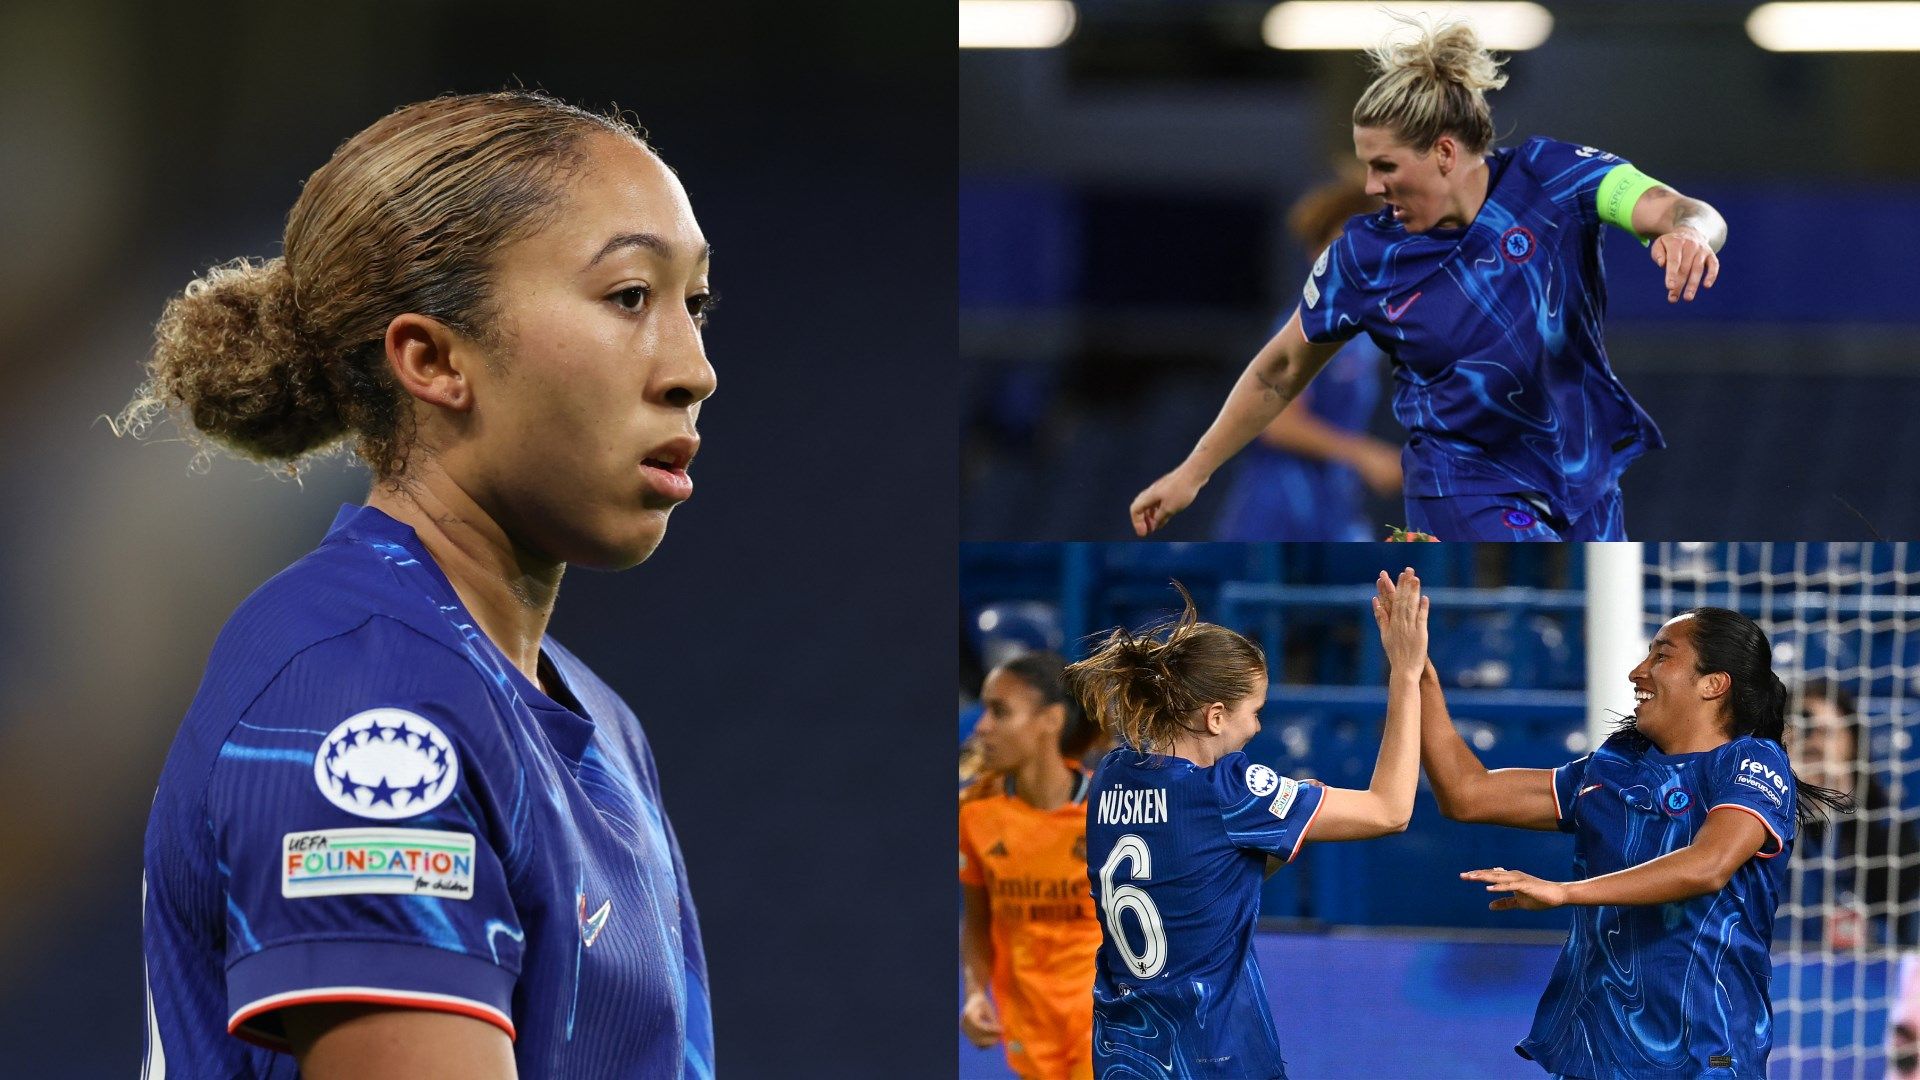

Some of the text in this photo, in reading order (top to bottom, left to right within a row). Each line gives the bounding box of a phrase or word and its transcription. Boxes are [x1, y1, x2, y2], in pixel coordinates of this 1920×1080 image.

[1738, 775, 1781, 806] feverup.com
[1740, 758, 1788, 795] fever
[1097, 784, 1168, 825] NÜSKEN
[288, 834, 328, 852] UEFA
[288, 848, 470, 876] FOUNDATION
[414, 877, 469, 893] for children
[1099, 833, 1168, 980] 6
